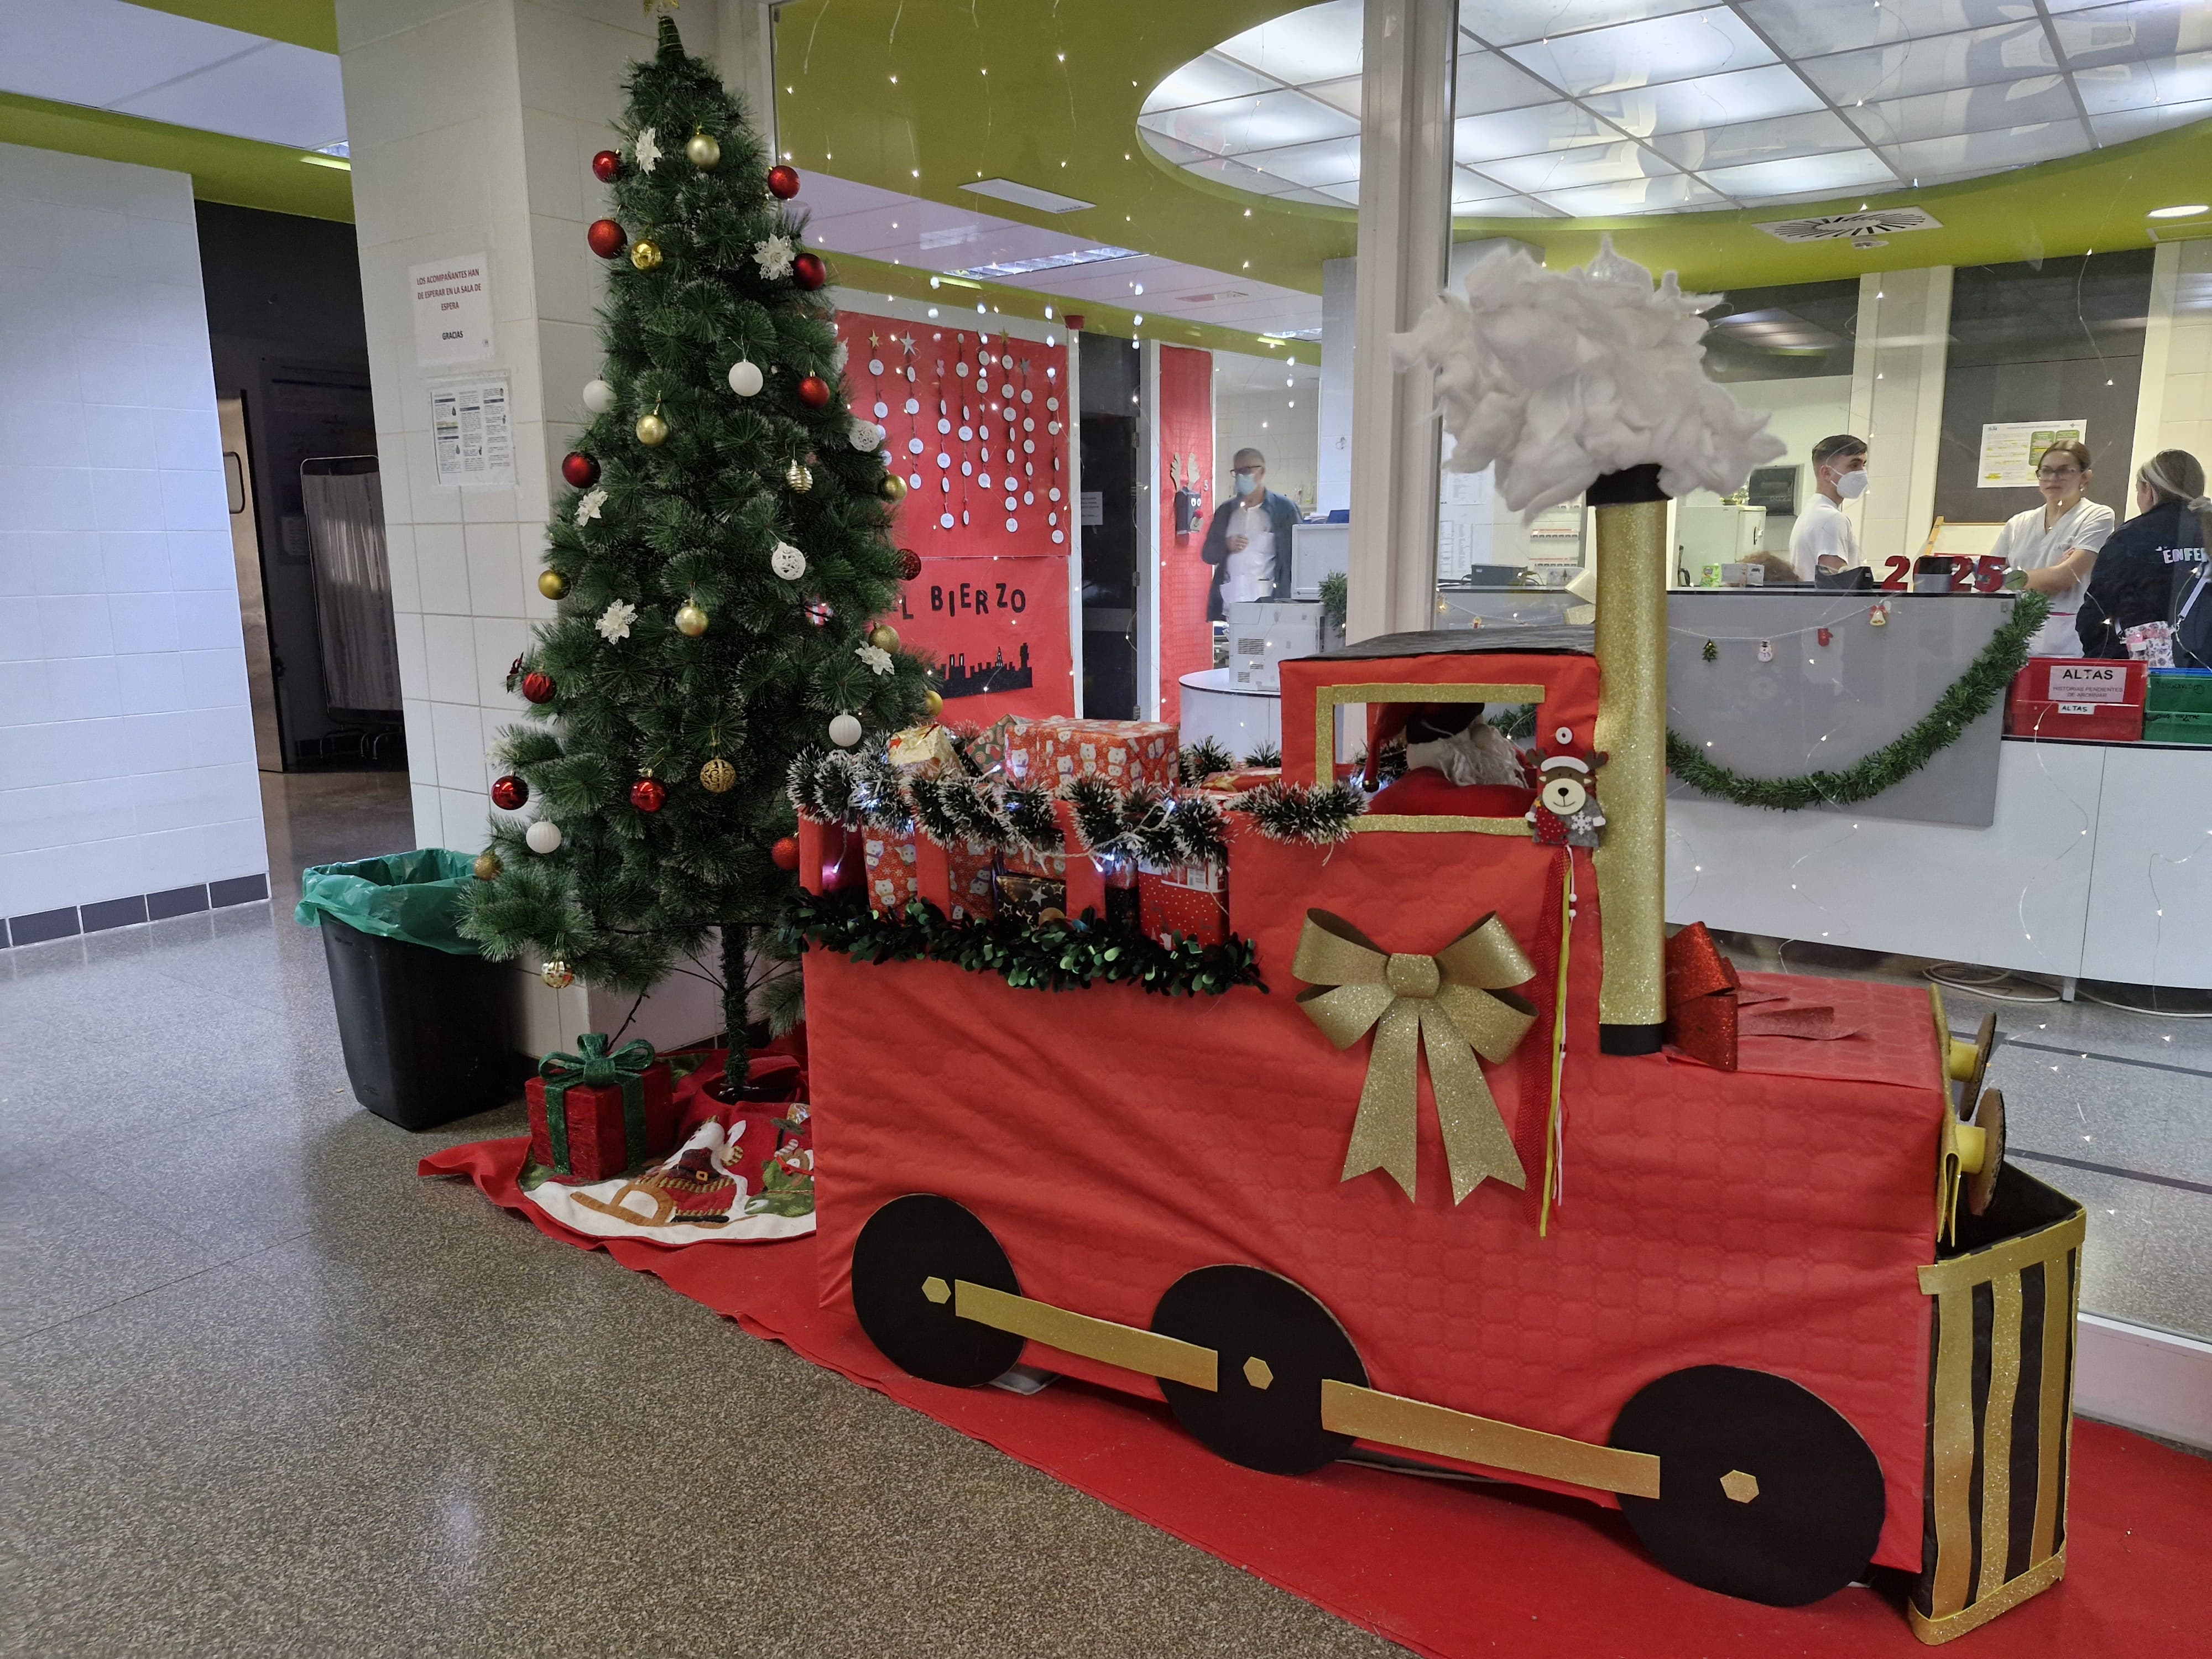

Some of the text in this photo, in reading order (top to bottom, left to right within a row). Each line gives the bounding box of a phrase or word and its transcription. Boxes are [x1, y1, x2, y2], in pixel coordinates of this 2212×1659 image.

[416, 268, 479, 285] LOS ACOMPAÑANTES HAN
[425, 289, 446, 299] ESPERAR
[461, 284, 474, 293] SALA
[441, 301, 460, 311] ESPERA
[442, 331, 463, 340] GRACIAS
[1881, 555, 2007, 593] 225
[931, 583, 1026, 617] BIERZO
[2062, 669, 2114, 680] ALTAS
